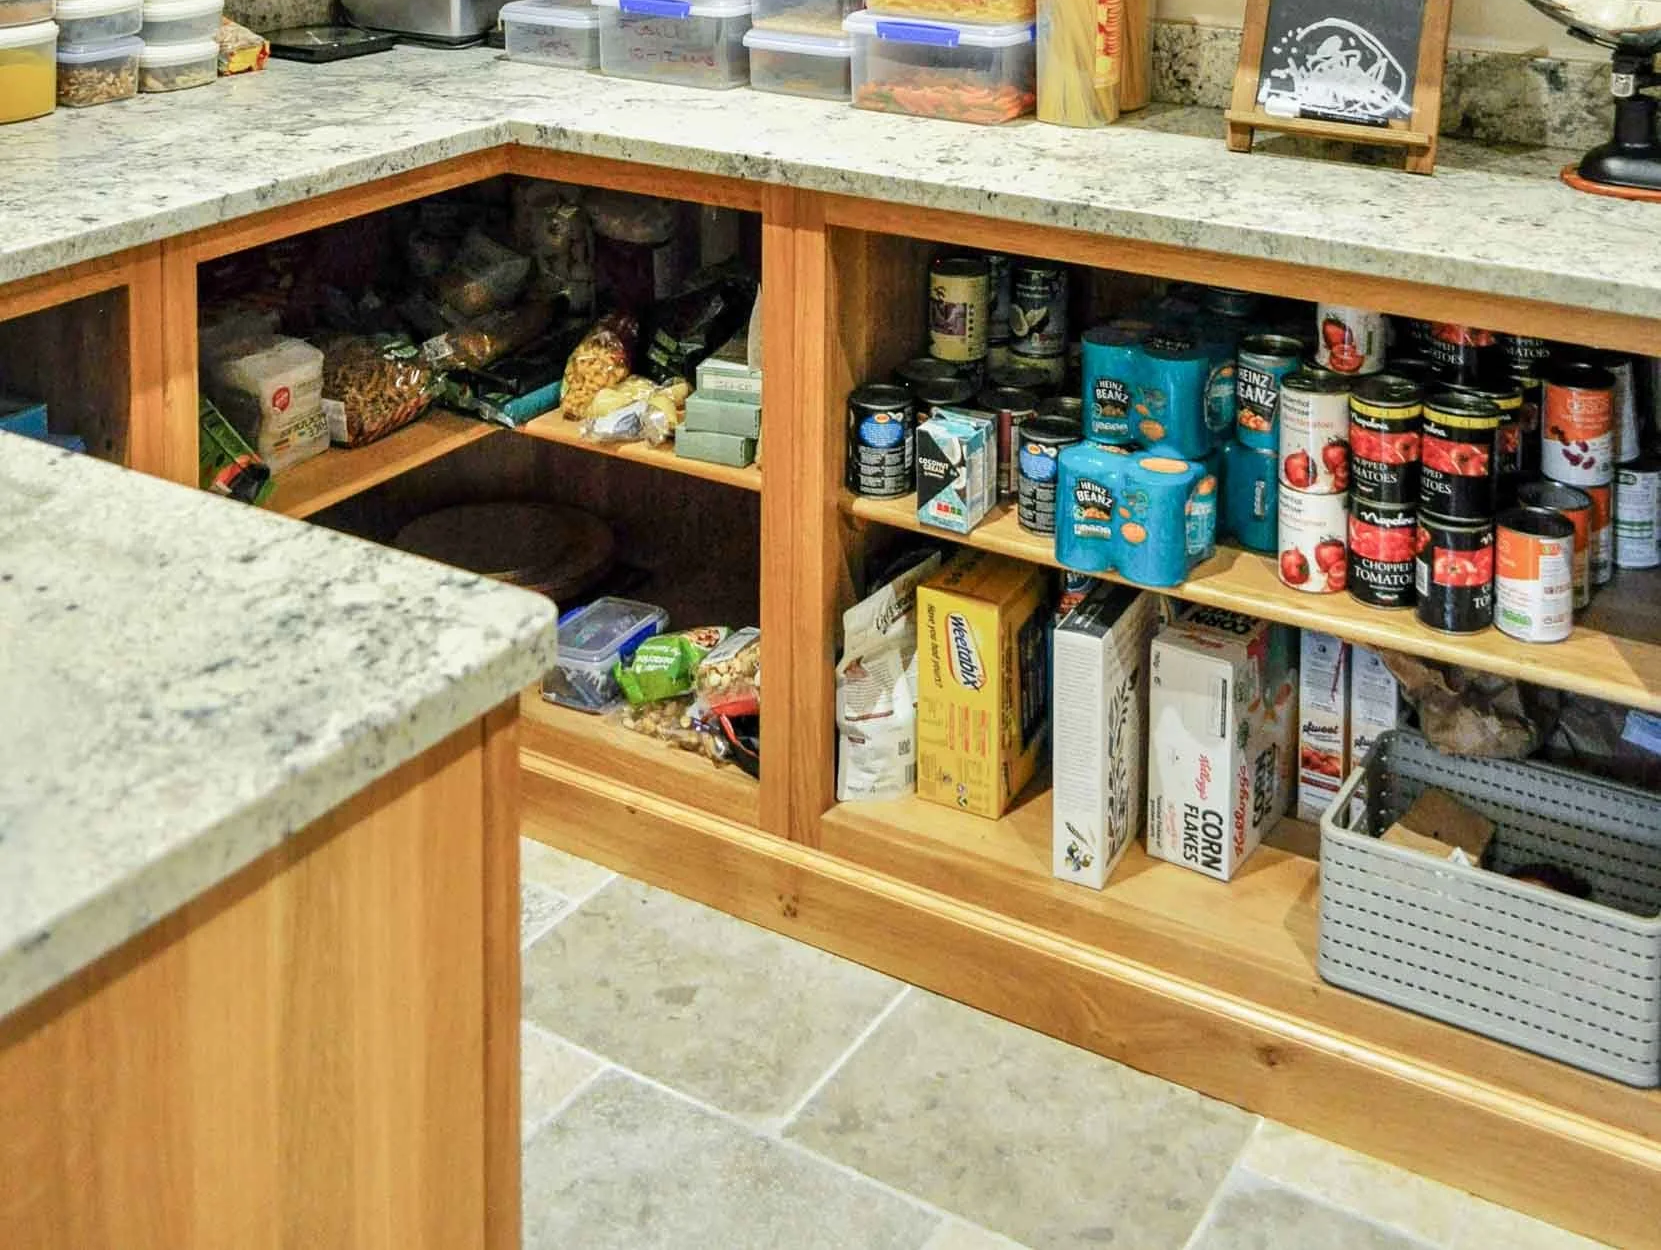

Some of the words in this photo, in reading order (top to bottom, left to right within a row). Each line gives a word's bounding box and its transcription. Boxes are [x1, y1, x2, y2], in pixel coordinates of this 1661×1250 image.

[1096, 388, 1129, 404] BEANZ
[1099, 380, 1123, 393] HEINZ
[1237, 381, 1278, 407] EANZ
[1076, 489, 1113, 508] BEANZ
[1080, 481, 1107, 496] HEINZ
[950, 615, 981, 692] Weetabix
[1184, 802, 1200, 863] FLAKES
[1201, 809, 1224, 872] CORN
